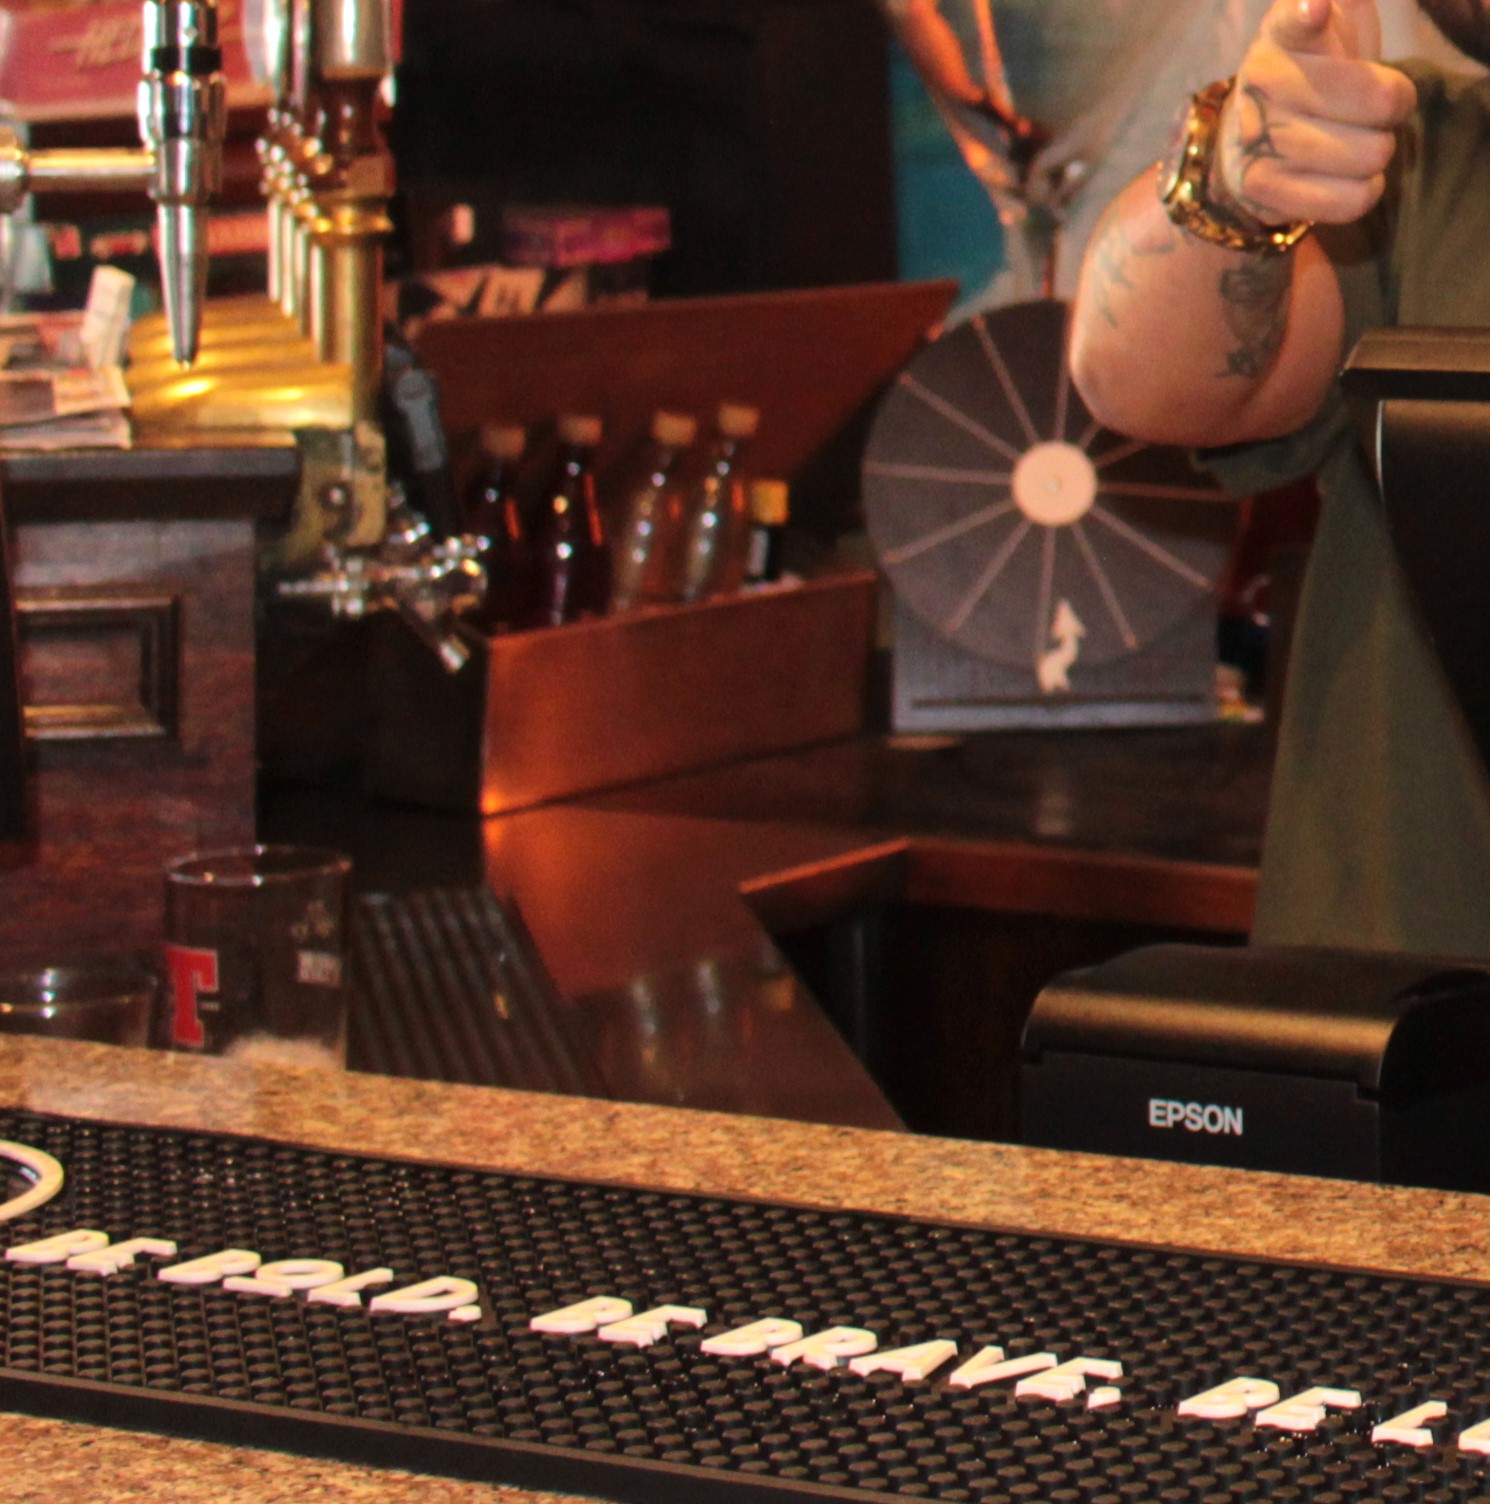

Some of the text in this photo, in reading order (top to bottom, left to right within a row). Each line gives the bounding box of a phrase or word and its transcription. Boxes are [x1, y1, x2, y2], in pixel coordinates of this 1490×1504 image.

[1149, 1098, 1243, 1136] EPSON
[5, 1229, 177, 1275] BE
[530, 1296, 707, 1347] BE
[1178, 1377, 1362, 1430] BE
